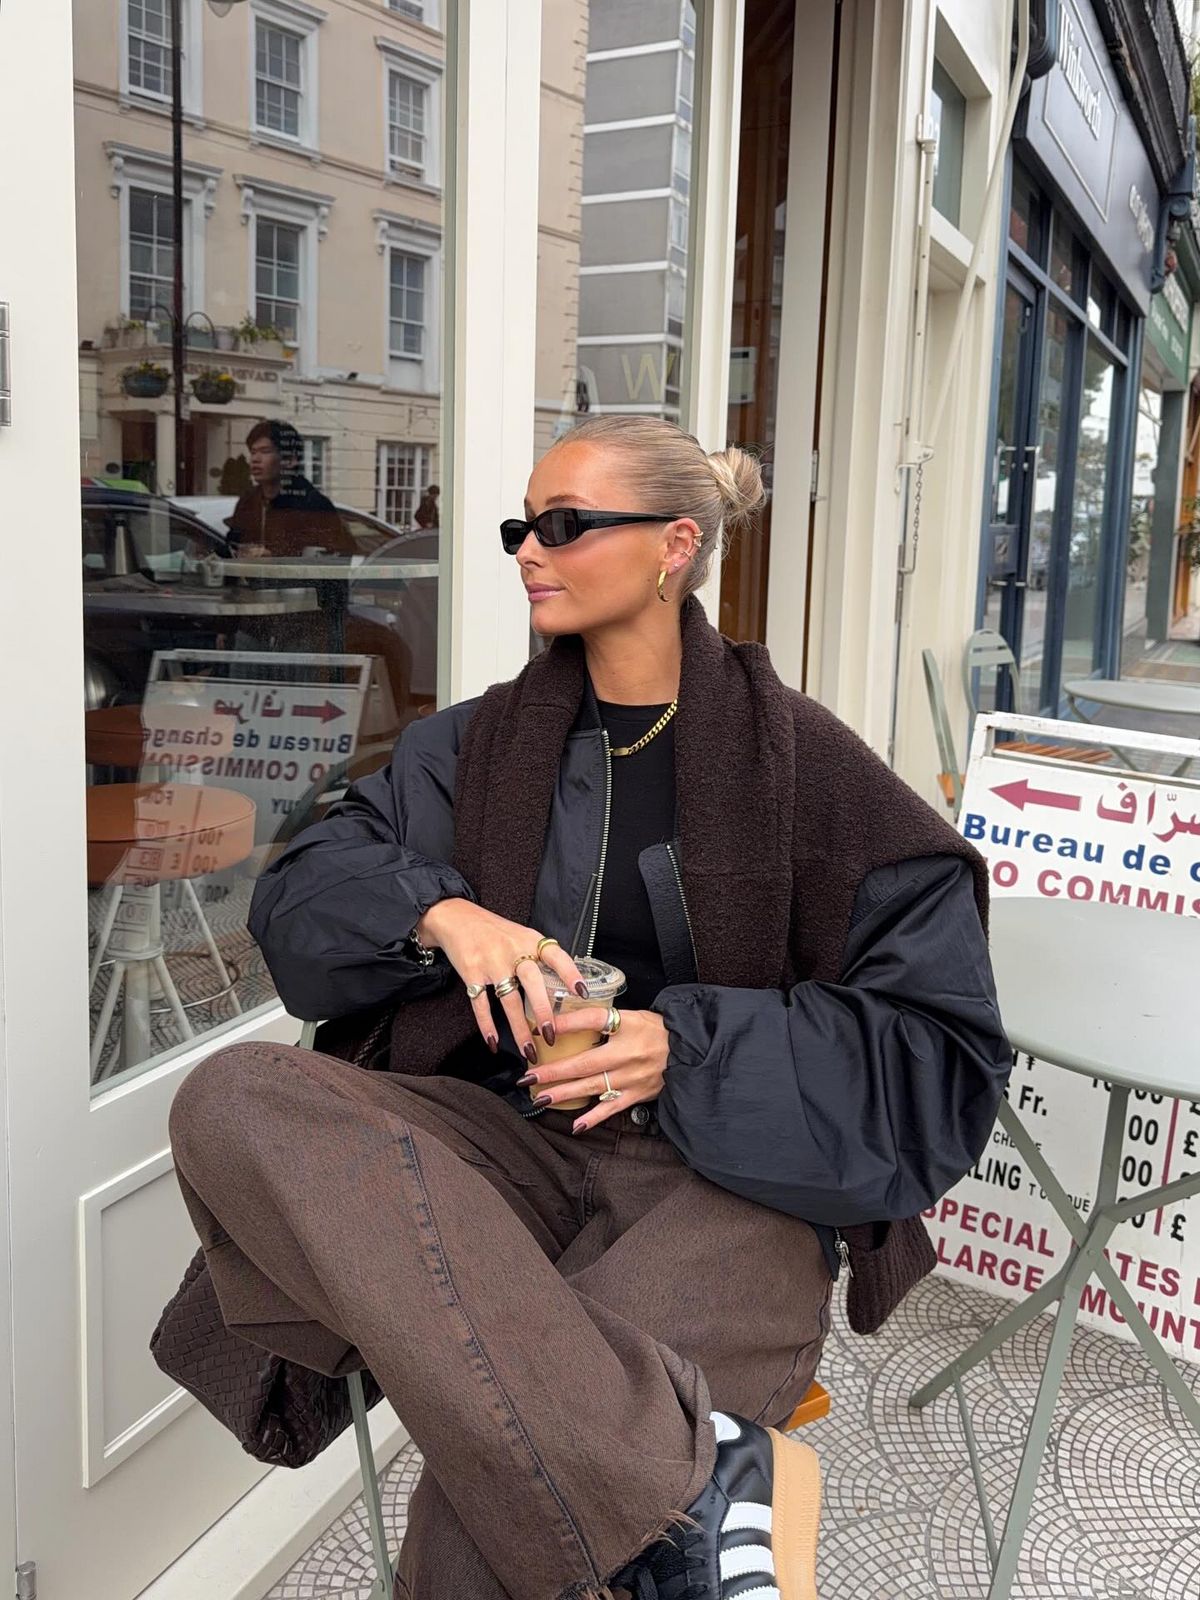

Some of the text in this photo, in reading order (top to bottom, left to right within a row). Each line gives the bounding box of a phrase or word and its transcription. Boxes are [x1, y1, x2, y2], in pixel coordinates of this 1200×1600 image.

[963, 813, 1105, 864] Bureau
[1122, 844, 1171, 876] de
[983, 857, 1019, 888] O
[1019, 1084, 1047, 1117] Fr.
[1183, 1129, 1199, 1157] £
[967, 1157, 1022, 1191] LING
[1170, 1213, 1187, 1242] £
[936, 1236, 1045, 1294] LARGE
[1072, 1238, 1180, 1297] TES
